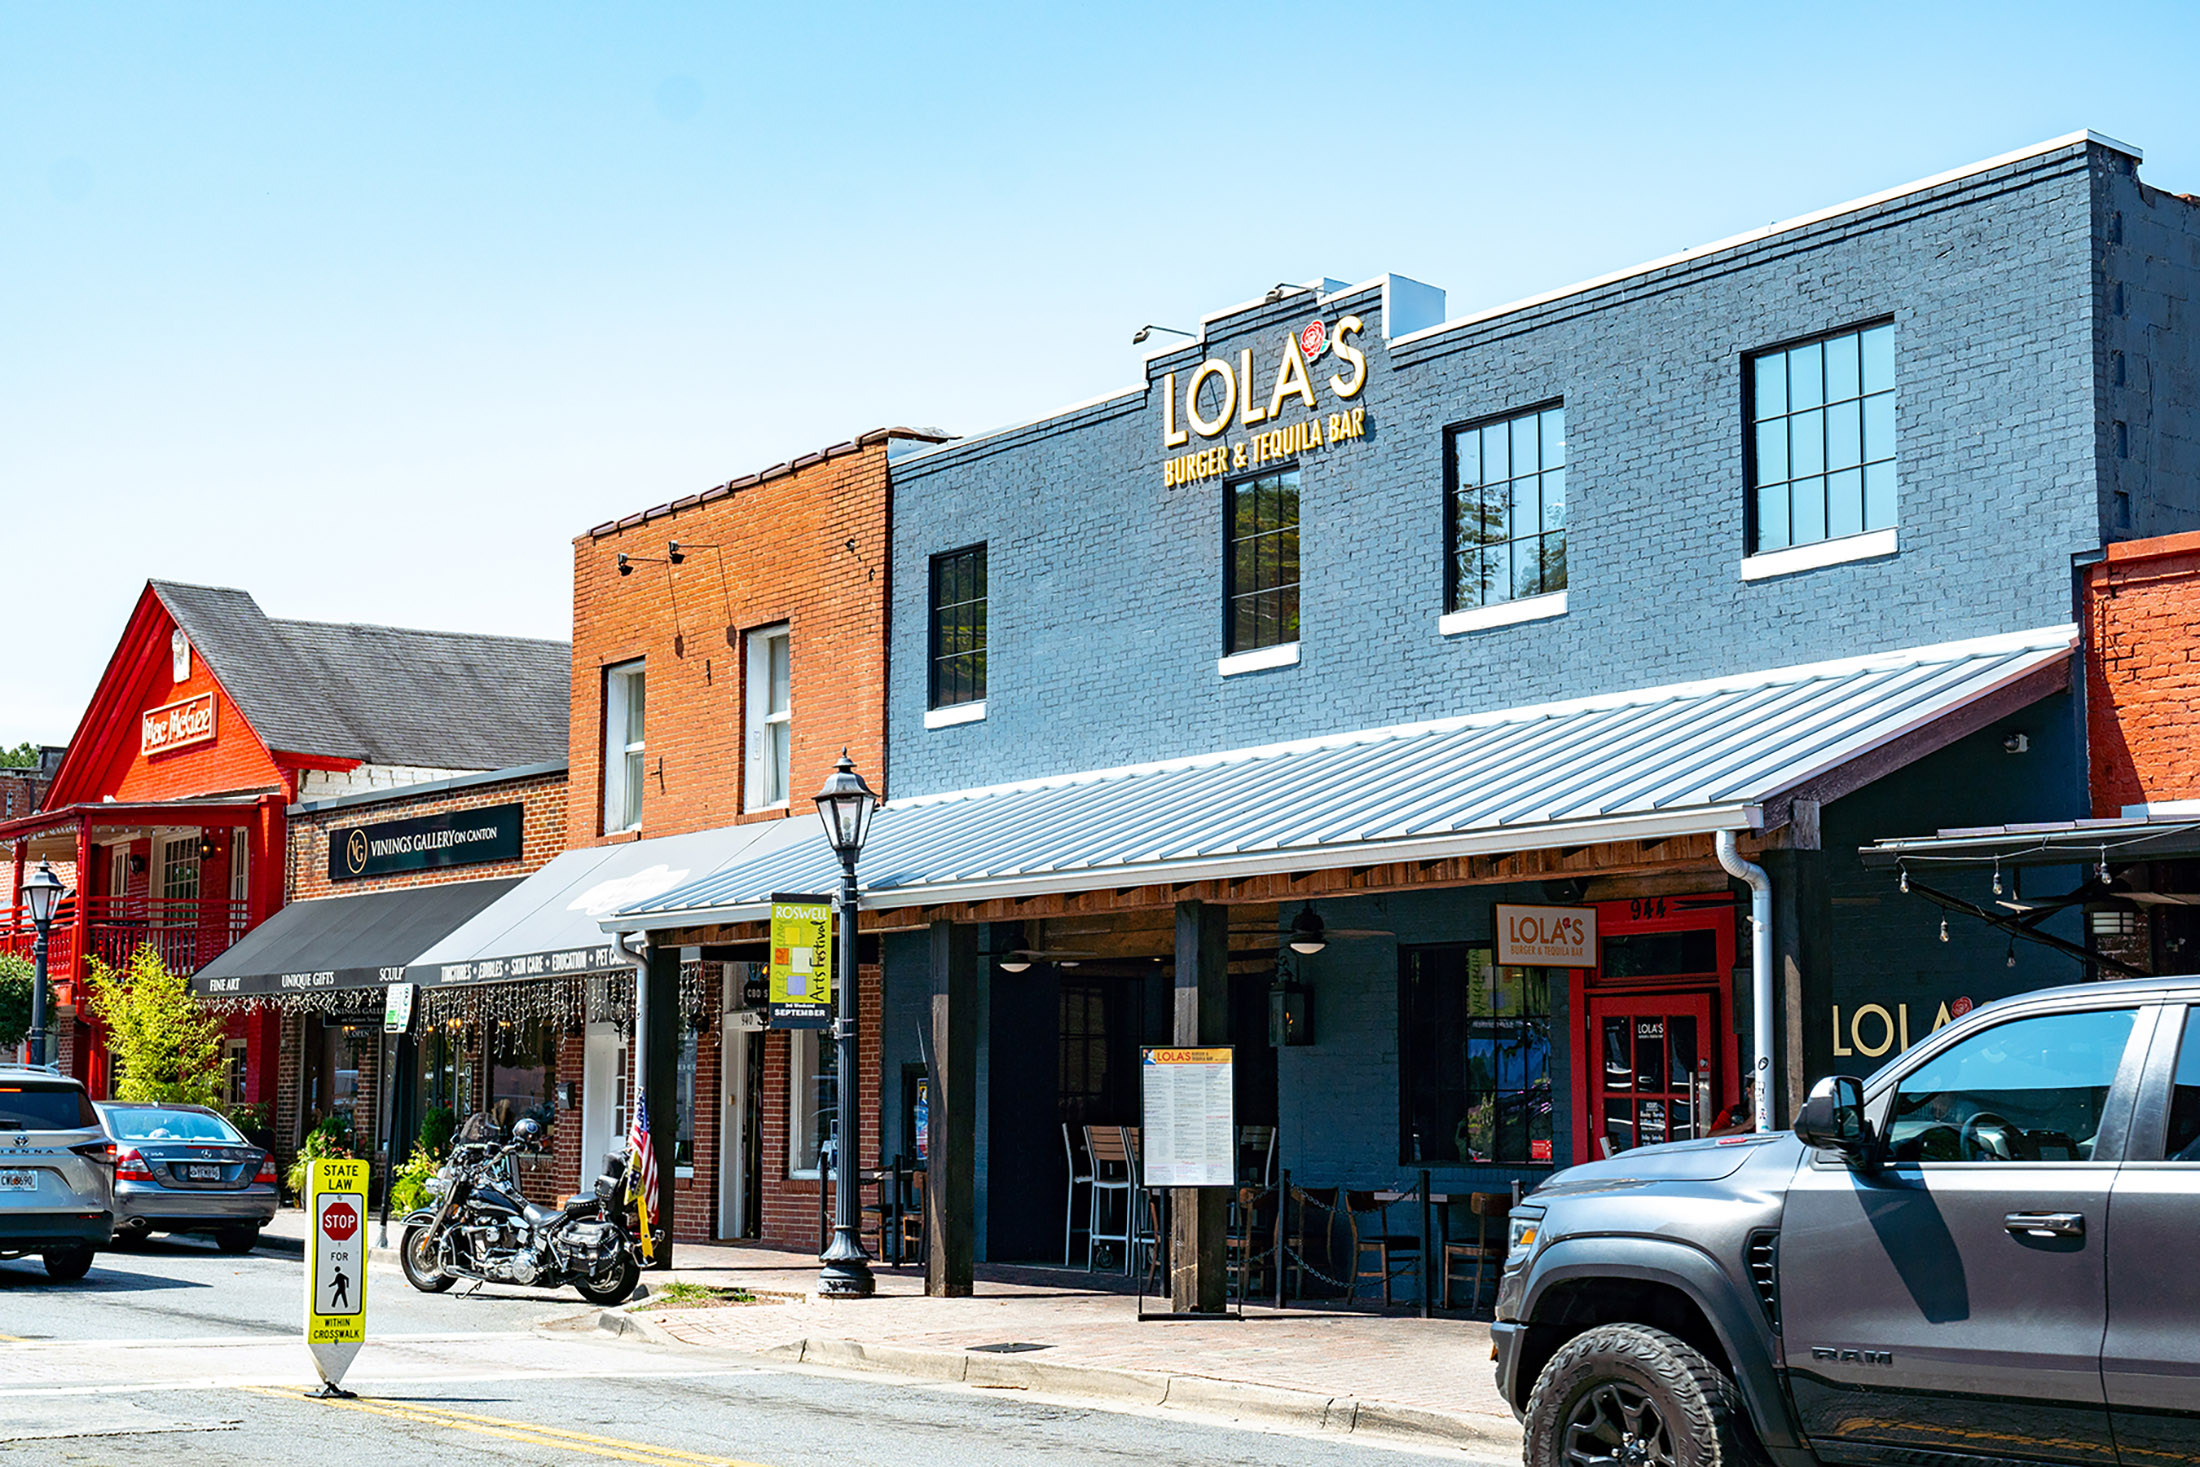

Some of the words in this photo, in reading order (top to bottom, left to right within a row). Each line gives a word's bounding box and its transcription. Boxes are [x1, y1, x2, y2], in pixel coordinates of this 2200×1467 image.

[1163, 315, 1368, 448] LOLA'S
[1163, 445, 1229, 488] BURGER
[1232, 442, 1248, 469] &
[1251, 418, 1324, 463] TEQUILA
[1328, 406, 1365, 443] BAR
[143, 717, 168, 746] Mac
[168, 701, 210, 741] McGee
[370, 836, 412, 857] VININGS
[413, 830, 455, 851] GALLERY
[455, 831, 466, 844] ON
[466, 826, 497, 842] CANTON
[775, 905, 828, 920] ROSWELL
[1630, 897, 1667, 921] 944
[1509, 916, 1585, 946] LOLA'S
[808, 920, 826, 968] Festival
[1510, 945, 1536, 955] BURGER
[1537, 946, 1542, 956] &
[1544, 946, 1570, 957] TEQUILA
[1571, 947, 1584, 957] BAR
[441, 963, 472, 983] TINCTURES
[478, 959, 504, 980] EDIBLES
[510, 956, 526, 976] SKIN
[526, 955, 544, 974] CARE
[552, 951, 587, 971] EDUCATION
[595, 948, 608, 967] PET
[209, 978, 226, 992] FINE
[226, 977, 241, 991] ART
[281, 973, 312, 990] UNIQUE
[312, 971, 335, 986] GIFTS
[809, 971, 826, 1002] Arts
[774, 1009, 826, 1017] SEPTEMBER
[1638, 1023, 1664, 1034] LOLA'S
[1157, 1051, 1192, 1062] LOLA'S
[323, 1164, 359, 1177] STATE
[328, 1179, 353, 1191] LAW
[324, 1214, 356, 1229] STOP
[330, 1252, 349, 1261] FOR
[324, 1318, 351, 1327] WITHIN
[313, 1329, 361, 1340] CROSSWALK
[1811, 1346, 1893, 1365] RAM
